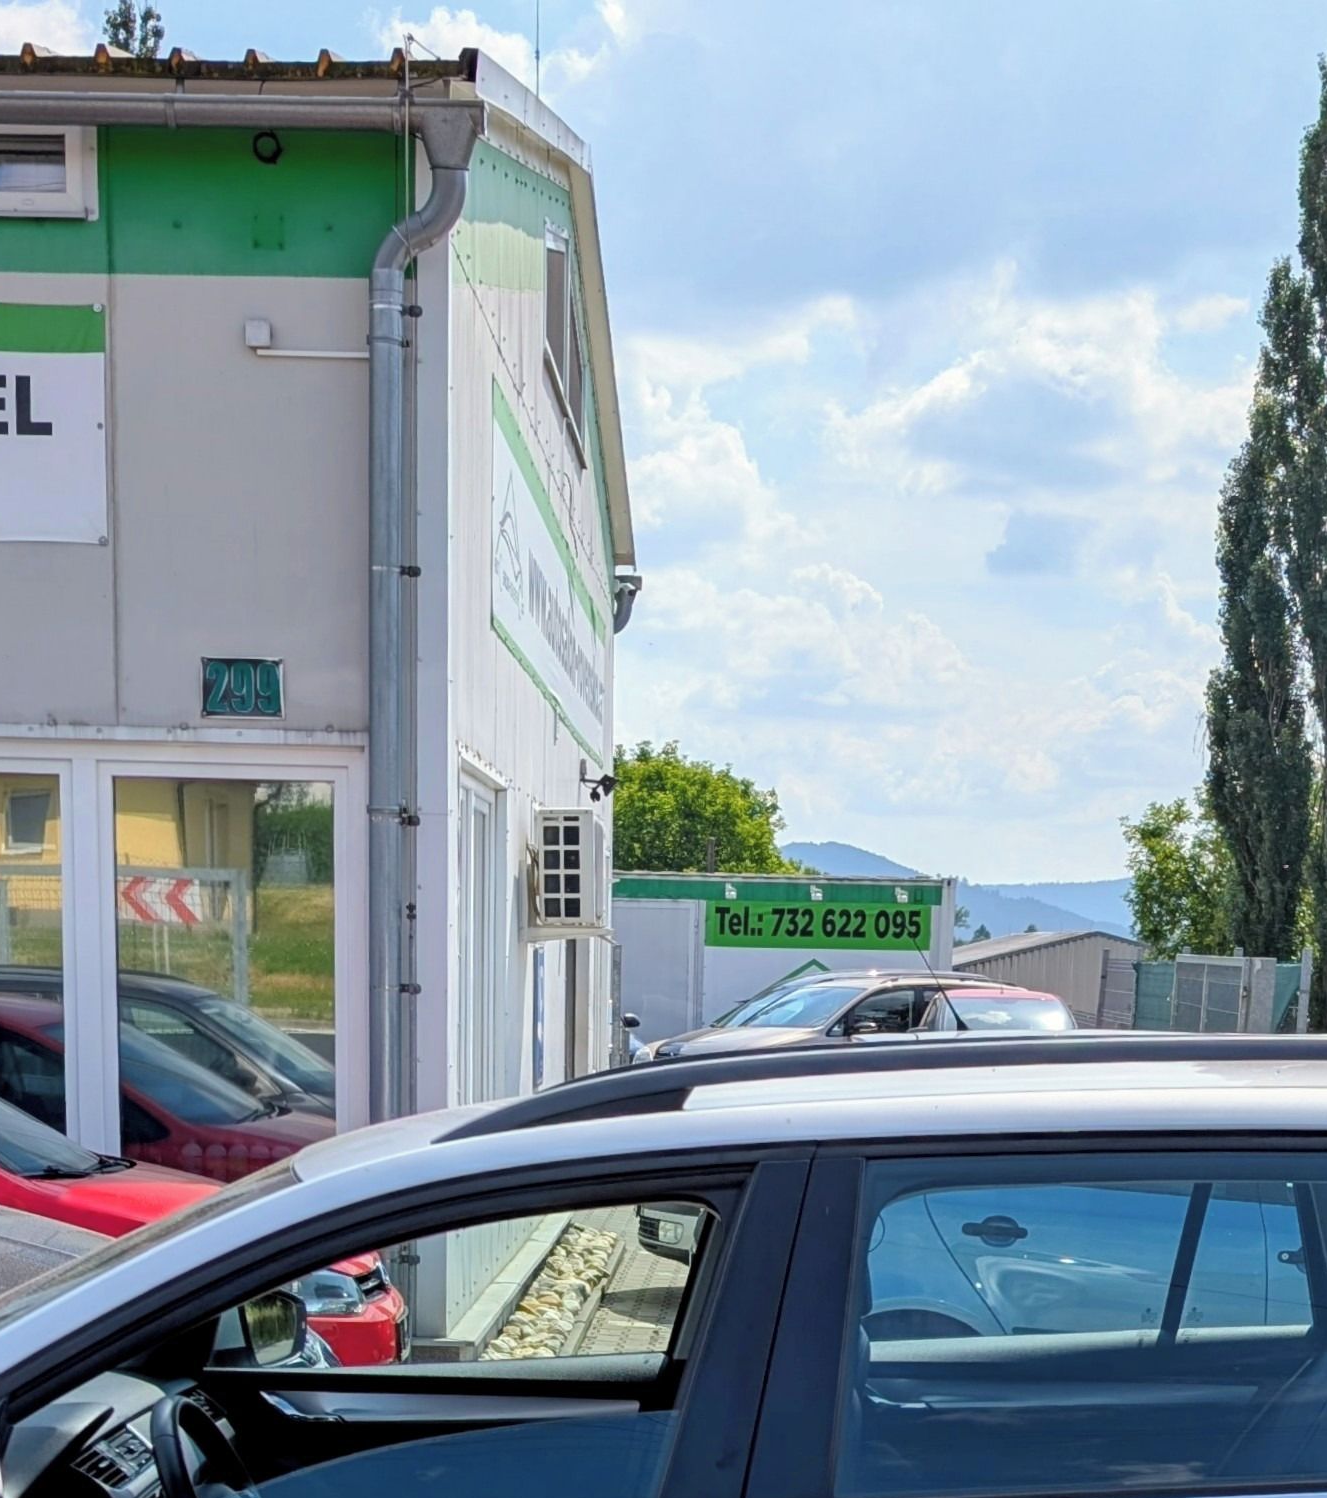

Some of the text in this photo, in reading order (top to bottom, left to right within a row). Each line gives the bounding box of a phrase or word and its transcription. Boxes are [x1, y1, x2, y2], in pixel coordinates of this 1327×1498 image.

[206, 661, 280, 713] 299
[715, 906, 922, 939] Tel.: 732 622 095
